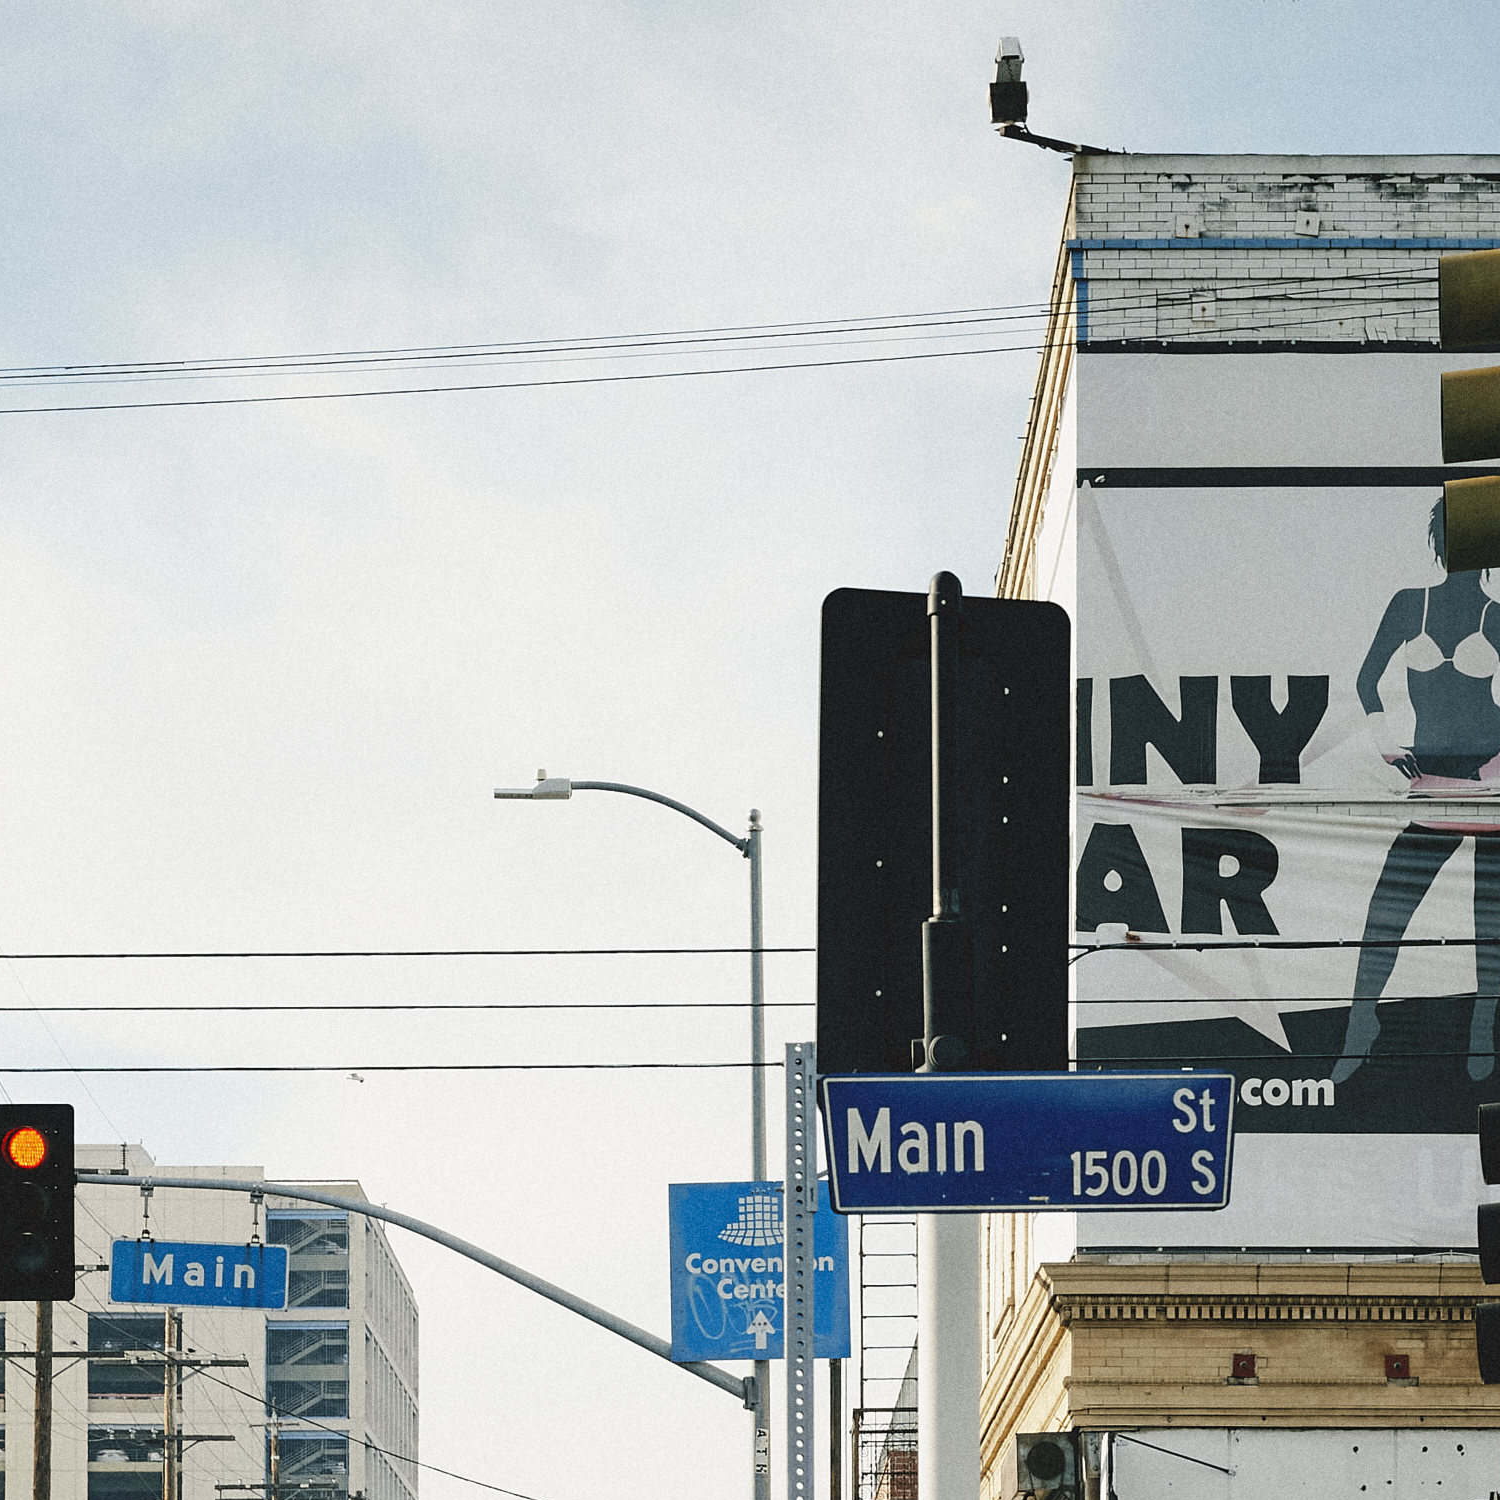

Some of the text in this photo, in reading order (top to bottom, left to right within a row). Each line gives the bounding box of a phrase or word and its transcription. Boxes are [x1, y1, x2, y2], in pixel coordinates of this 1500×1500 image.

[1238, 1077, 1336, 1107] com
[846, 1087, 1216, 1174] Main St
[1069, 1149, 1217, 1197] 1500 S
[142, 1252, 256, 1289] Main
[685, 1252, 835, 1275] Convenn
[716, 1278, 786, 1300] Cente
